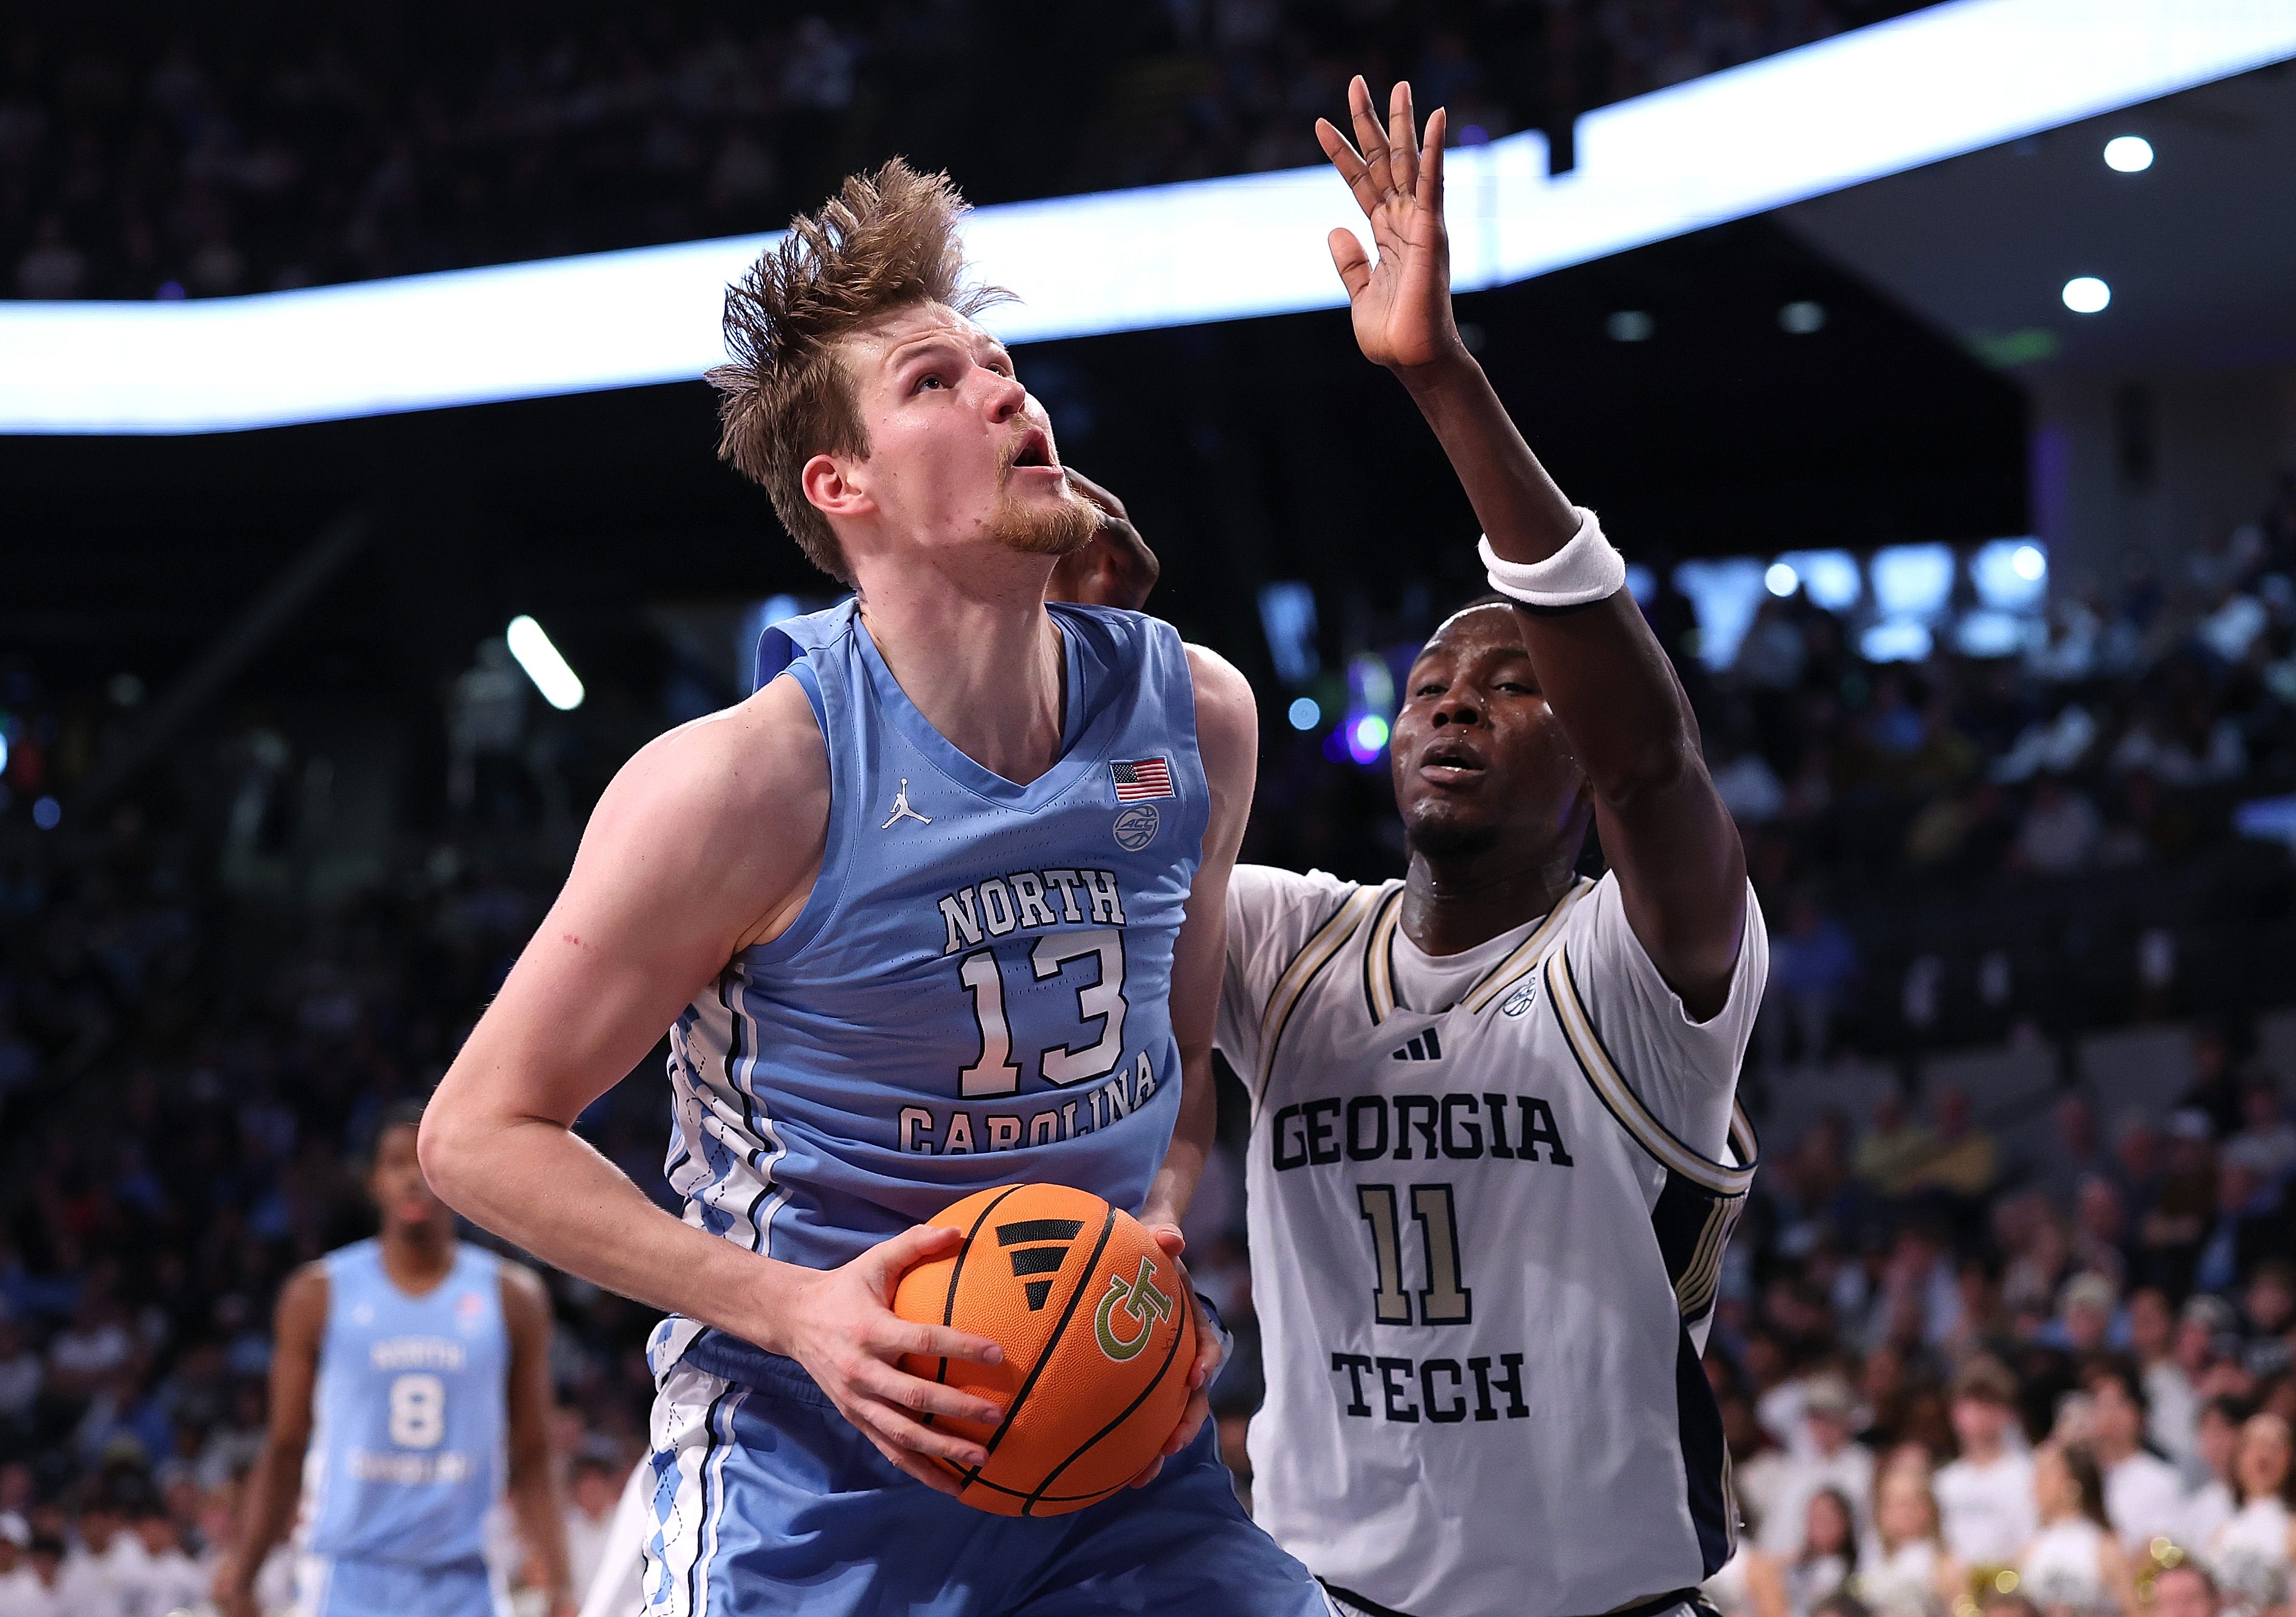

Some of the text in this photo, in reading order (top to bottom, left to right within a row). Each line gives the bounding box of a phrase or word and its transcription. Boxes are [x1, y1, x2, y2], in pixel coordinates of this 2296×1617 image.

[1120, 817, 1156, 828] ACC
[937, 868, 1127, 957] NORTH
[957, 928, 1129, 1101] 13
[898, 1049, 1157, 1156] CAROLINA
[1273, 1092, 1574, 1172] GEORGIA
[1356, 1184, 1472, 1326] 11
[1094, 1254, 1173, 1363] GT
[389, 1374, 446, 1449] 8
[1331, 1352, 1530, 1423] TECH
